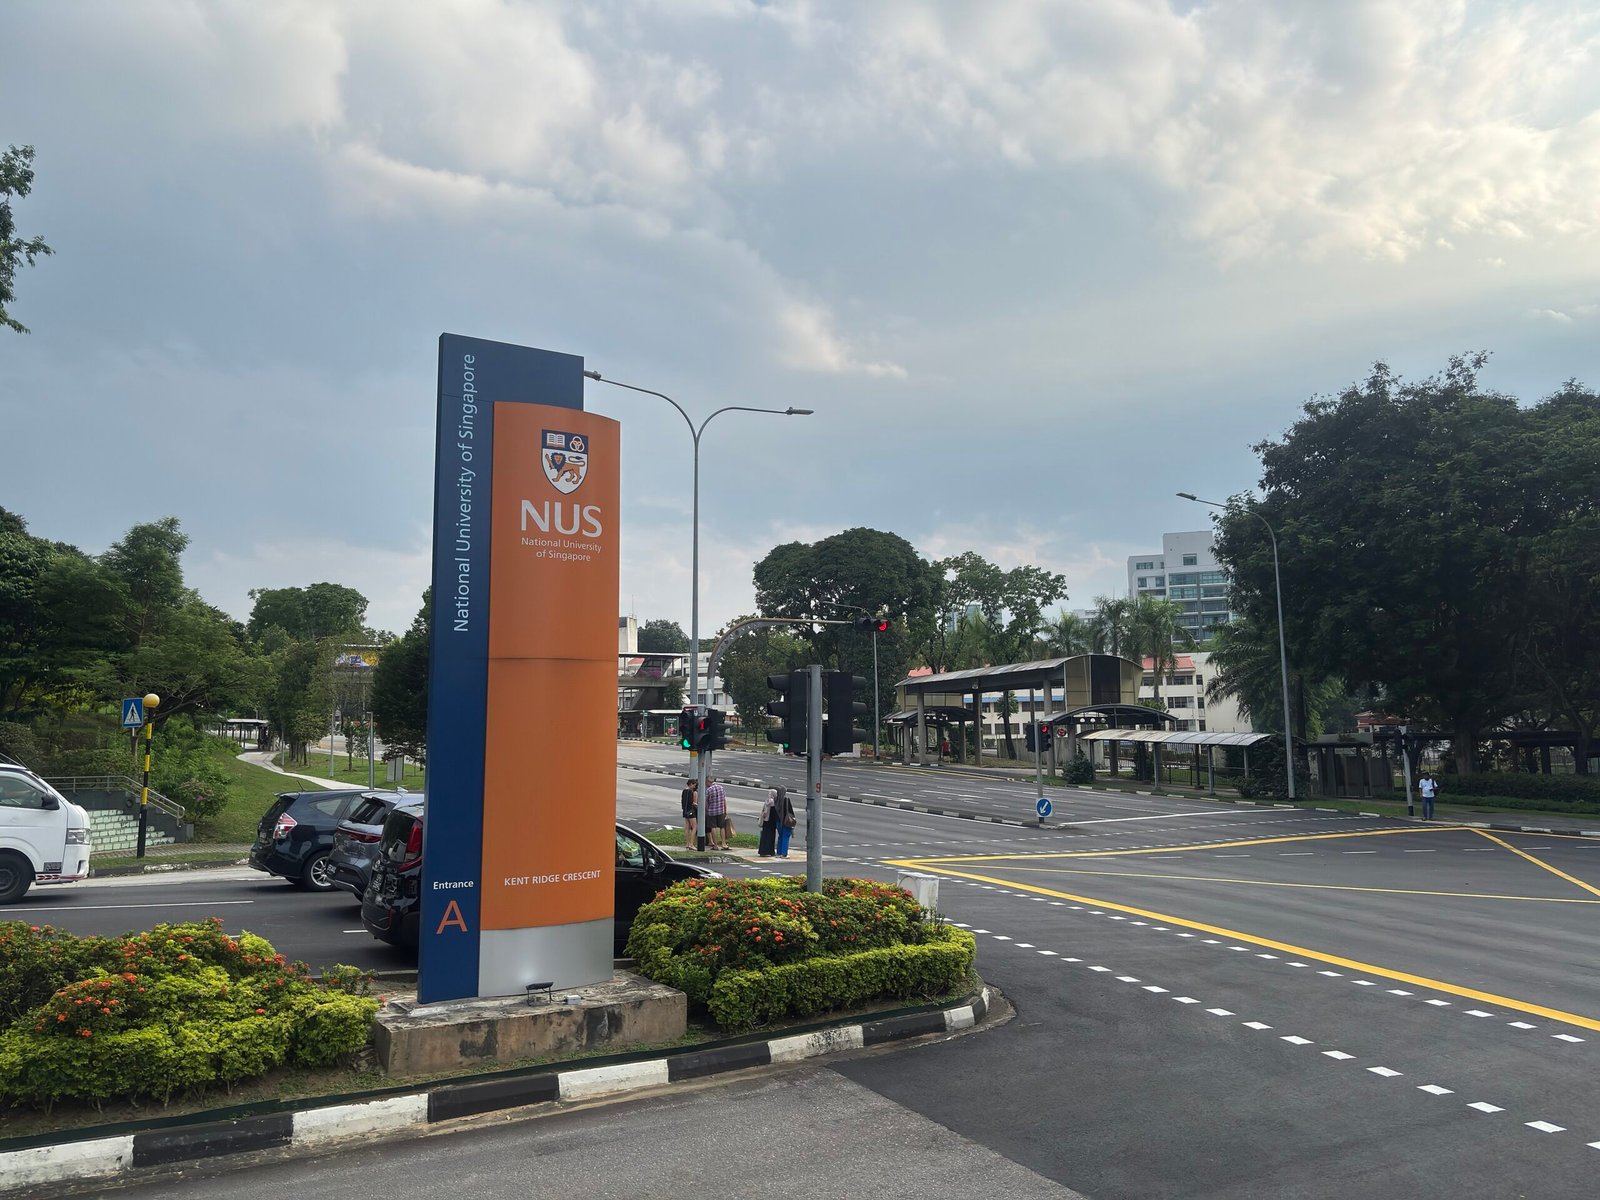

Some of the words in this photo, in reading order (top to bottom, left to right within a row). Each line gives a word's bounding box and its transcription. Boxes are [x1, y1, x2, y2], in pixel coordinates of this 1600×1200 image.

[458, 354, 478, 439] Singapore
[457, 442, 473, 462] of
[456, 466, 476, 551] University
[521, 499, 603, 538] NUS
[521, 537, 561, 548] National
[563, 540, 602, 554] University
[536, 549, 546, 558] of
[548, 550, 591, 562] Singapore
[454, 557, 470, 631] National
[433, 880, 474, 890] Entrance
[504, 876, 530, 886] KENT
[532, 874, 560, 884] RIDGE
[562, 869, 601, 882] CRESCENT
[436, 900, 469, 935] A
